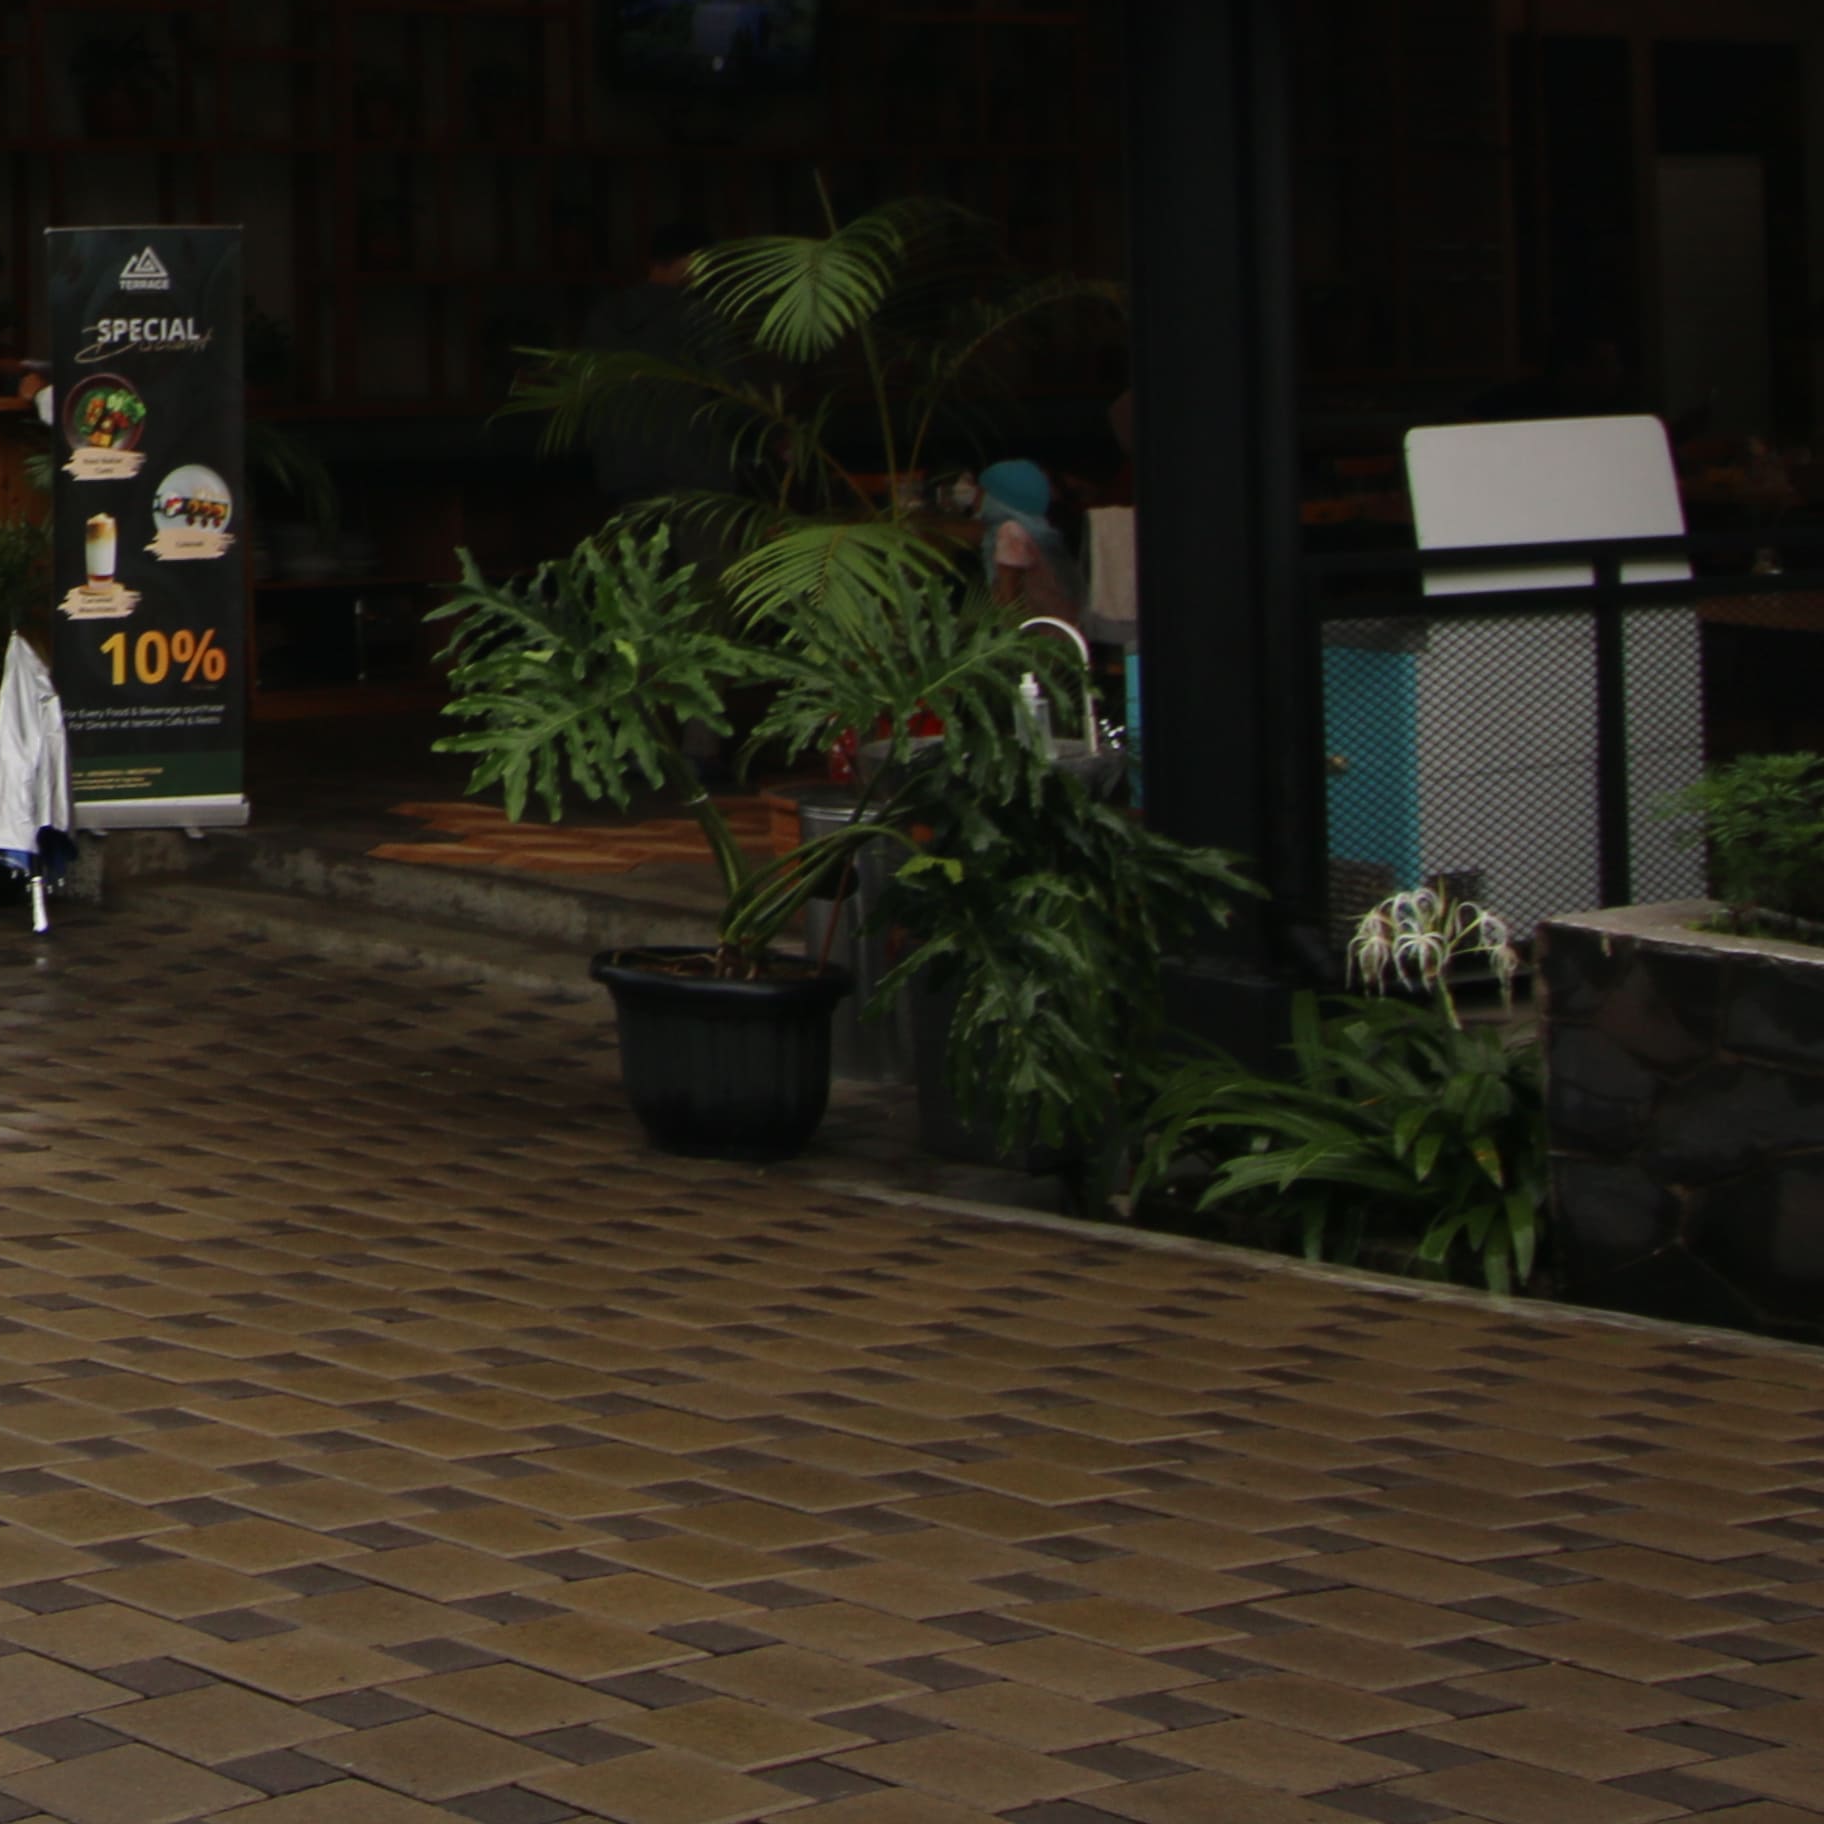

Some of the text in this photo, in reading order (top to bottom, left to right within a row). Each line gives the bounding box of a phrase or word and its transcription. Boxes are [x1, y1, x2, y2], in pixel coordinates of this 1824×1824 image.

[119, 278, 171, 290] TERRACE
[96, 317, 200, 343] SPECIAL
[99, 626, 228, 686] 10%
